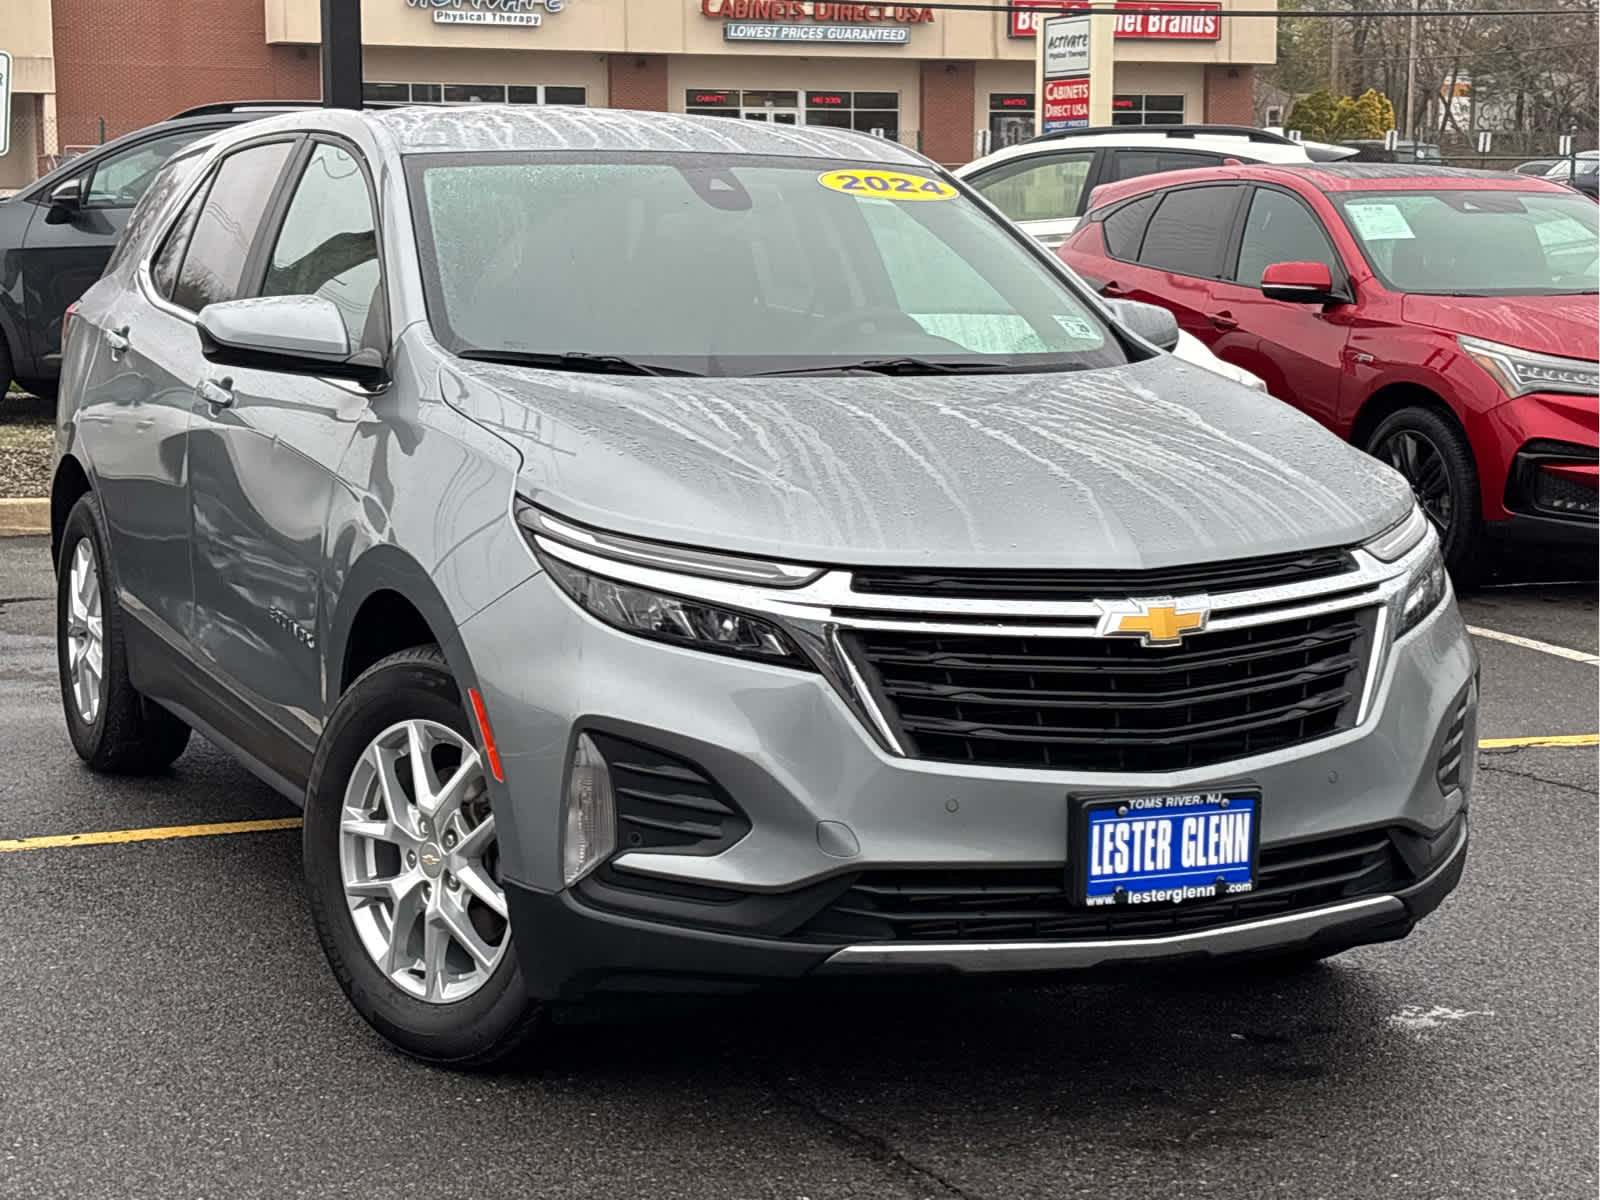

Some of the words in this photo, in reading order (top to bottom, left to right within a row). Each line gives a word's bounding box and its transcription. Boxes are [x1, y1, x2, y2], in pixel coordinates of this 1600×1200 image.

[436, 11, 486, 22] Physical
[492, 13, 540, 24] Therapy
[730, 26, 777, 38] LOWEST
[781, 27, 824, 39] PRICES
[827, 28, 906, 40] GUARANTEED
[1048, 33, 1088, 49] ACTIVATE
[1046, 84, 1089, 100] CABINETS
[1045, 104, 1071, 118] DIRECT
[1072, 103, 1088, 116] USA
[836, 174, 945, 195] 2024
[1128, 798, 1163, 810] TOMS
[1206, 793, 1222, 804] NJ
[1090, 819, 1172, 876] LESTER
[1181, 812, 1250, 868] GLENN
[1086, 894, 1116, 907] www.
[1127, 885, 1216, 904] lesterglenn
[1226, 881, 1252, 894] .com
